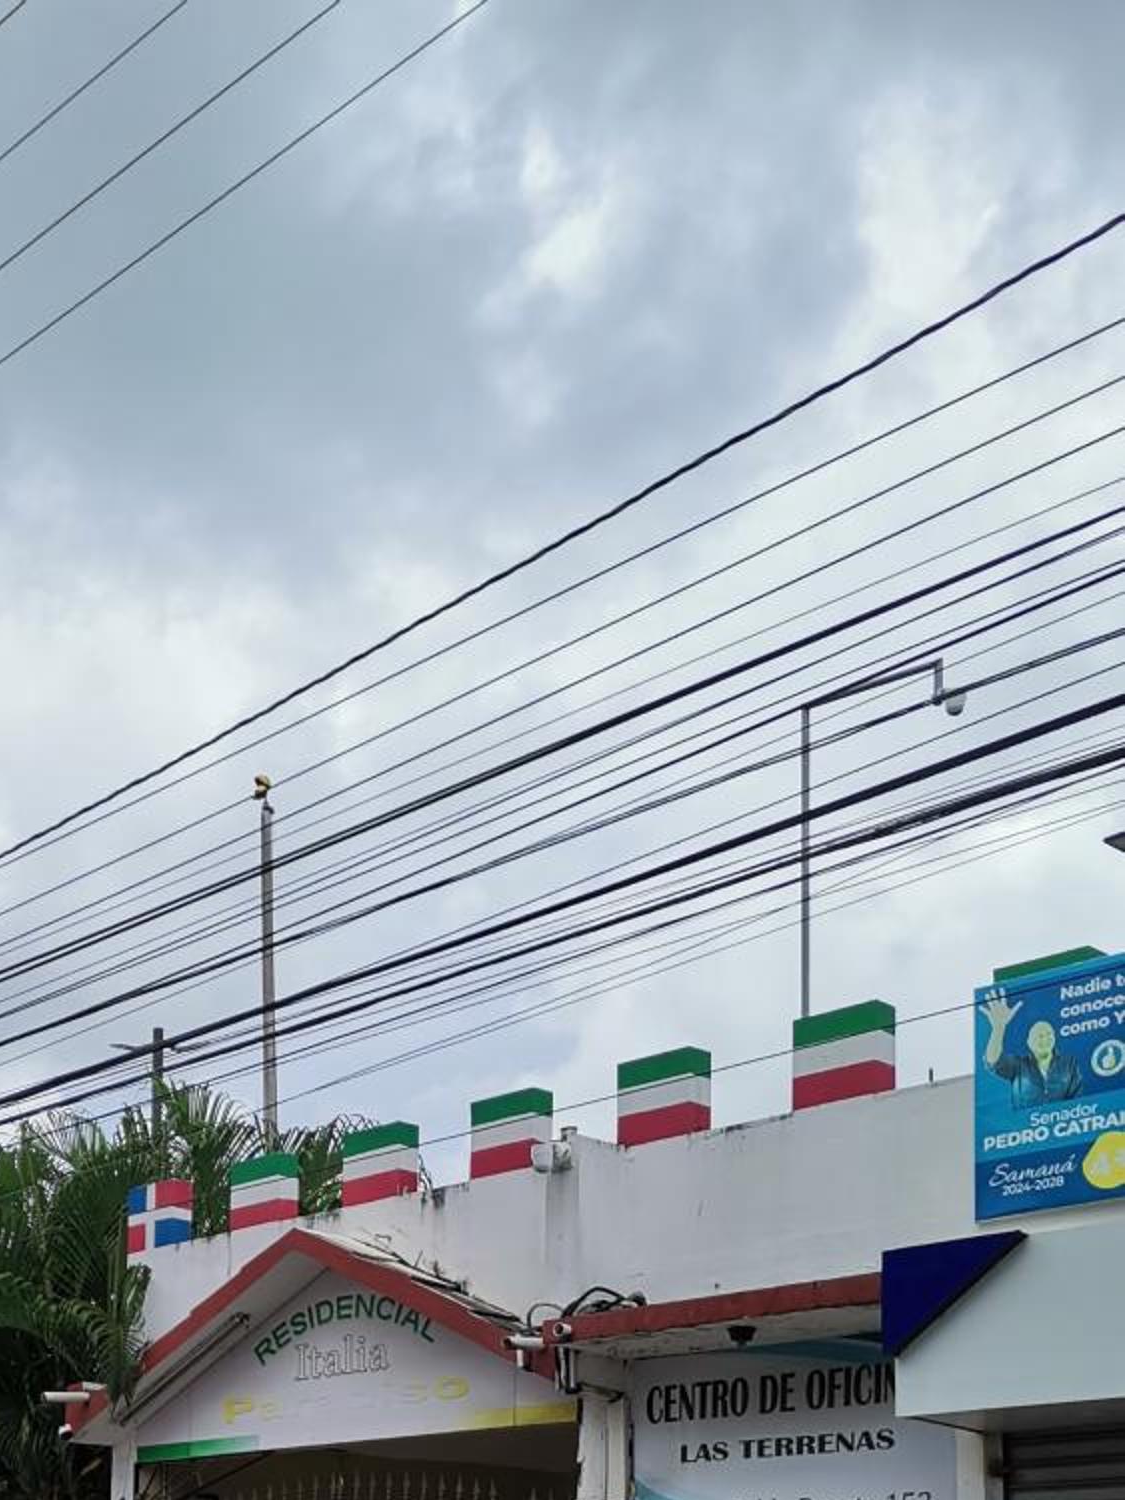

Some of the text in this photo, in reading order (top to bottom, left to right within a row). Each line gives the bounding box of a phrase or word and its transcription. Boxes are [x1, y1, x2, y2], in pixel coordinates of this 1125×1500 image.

[1060, 976, 1112, 1000] Nadie
[1060, 1009, 1125, 1037] como Y
[1030, 1103, 1098, 1127] Senador
[983, 1126, 1050, 1152] PEDRO
[988, 1153, 1076, 1187] Samaná
[1002, 1175, 1065, 1196] 2024-2028
[253, 1294, 437, 1366] RESIDENCIAL
[294, 1333, 391, 1382] Italia
[646, 1377, 749, 1425] CENTRO
[758, 1372, 796, 1416] DE
[680, 1428, 896, 1464] LAS TERRENAS
